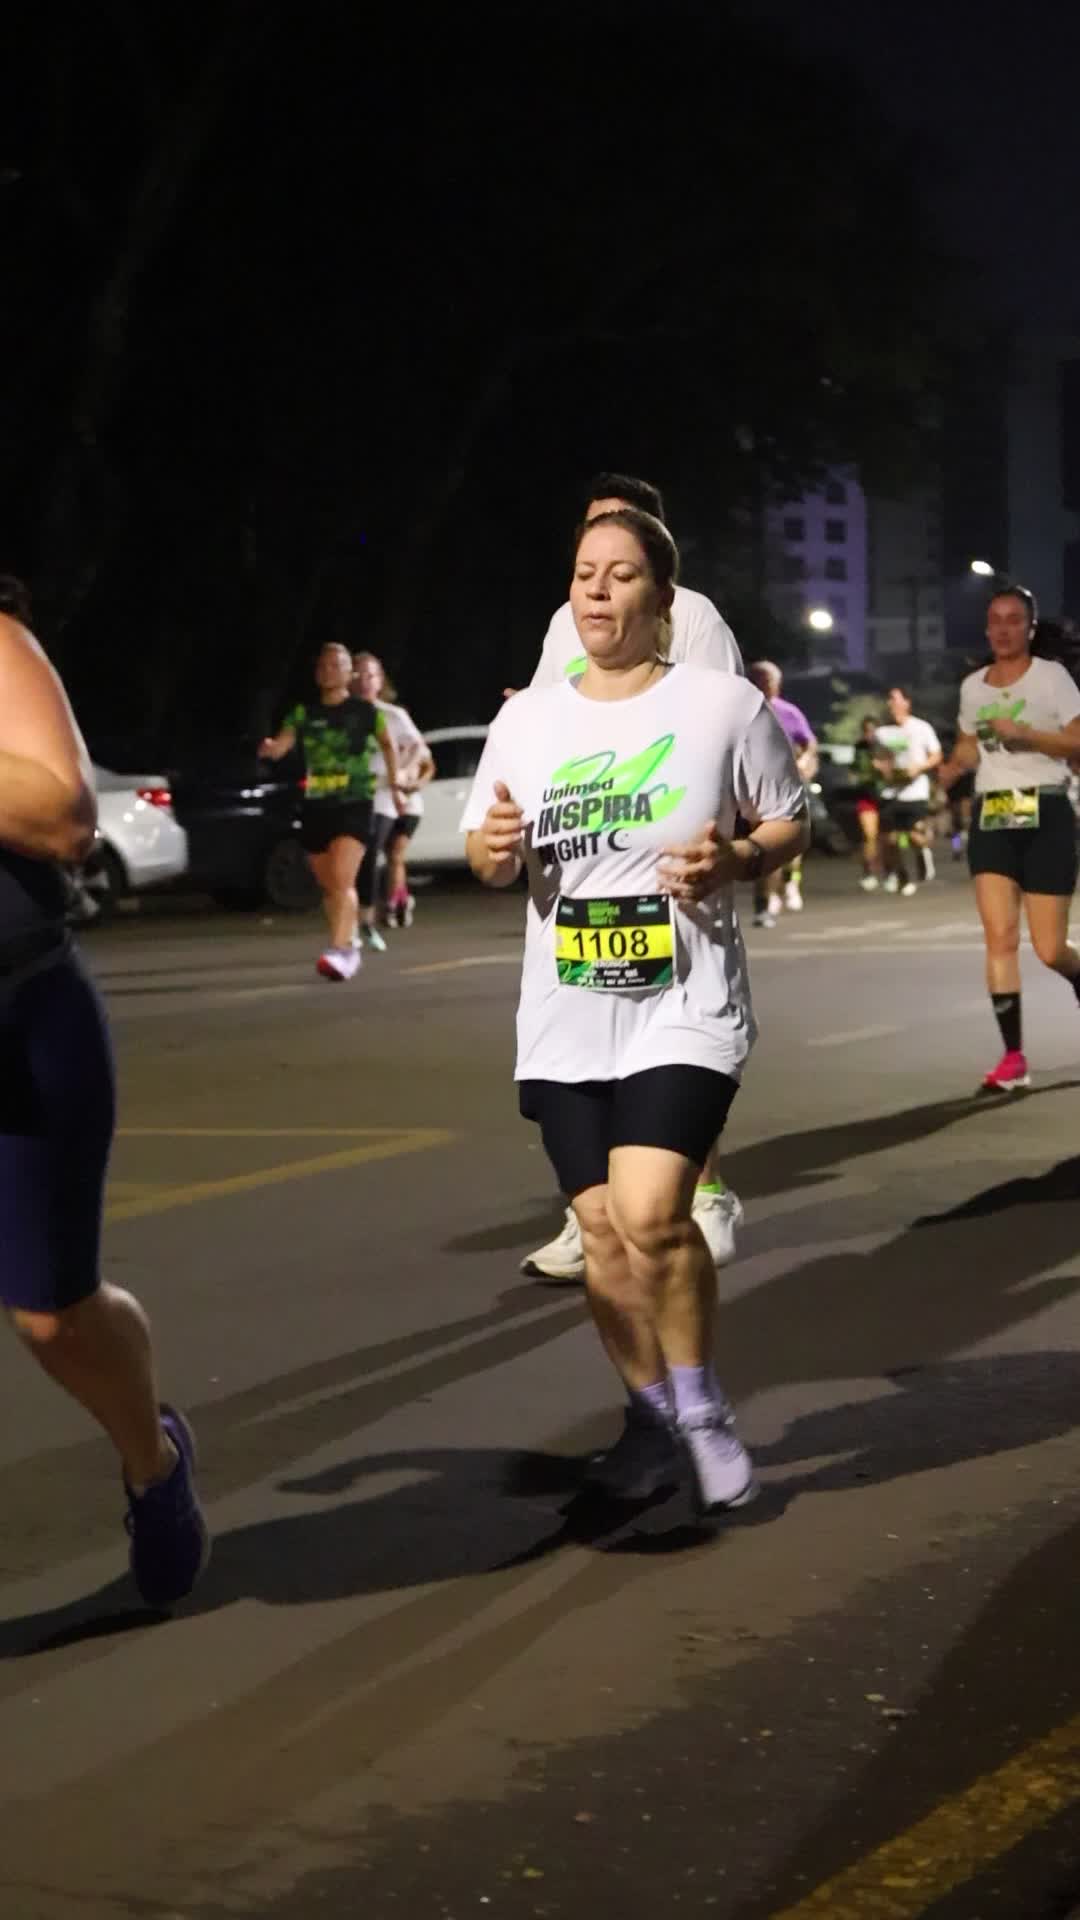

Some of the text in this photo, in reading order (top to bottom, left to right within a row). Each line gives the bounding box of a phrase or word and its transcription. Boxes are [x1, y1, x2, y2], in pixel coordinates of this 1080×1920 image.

[543, 777, 614, 803] Unimed
[537, 792, 653, 838] INSPIRA
[573, 928, 649, 959] 1108
